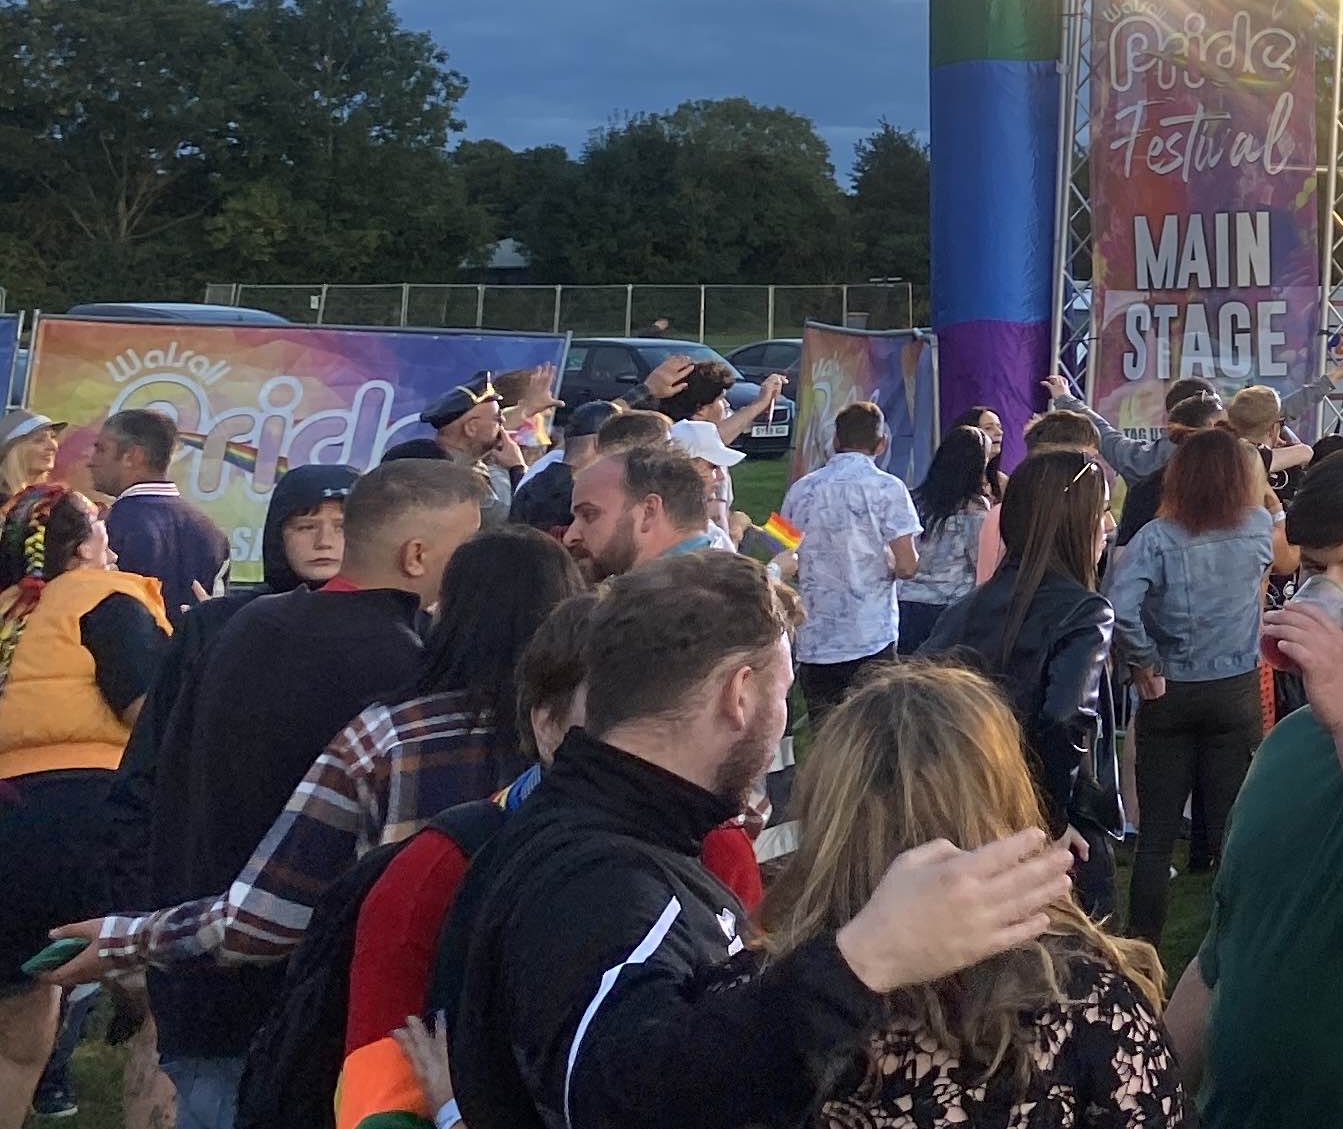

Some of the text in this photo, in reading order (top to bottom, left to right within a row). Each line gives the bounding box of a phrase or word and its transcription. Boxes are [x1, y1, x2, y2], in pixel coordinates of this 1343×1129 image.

[1109, 11, 1297, 91] Pride
[1110, 92, 1295, 183] Festival
[1133, 211, 1270, 290] MAIN
[105, 342, 231, 383] Walsall
[1122, 300, 1288, 380] STAGE
[1123, 427, 1149, 440] TAG
